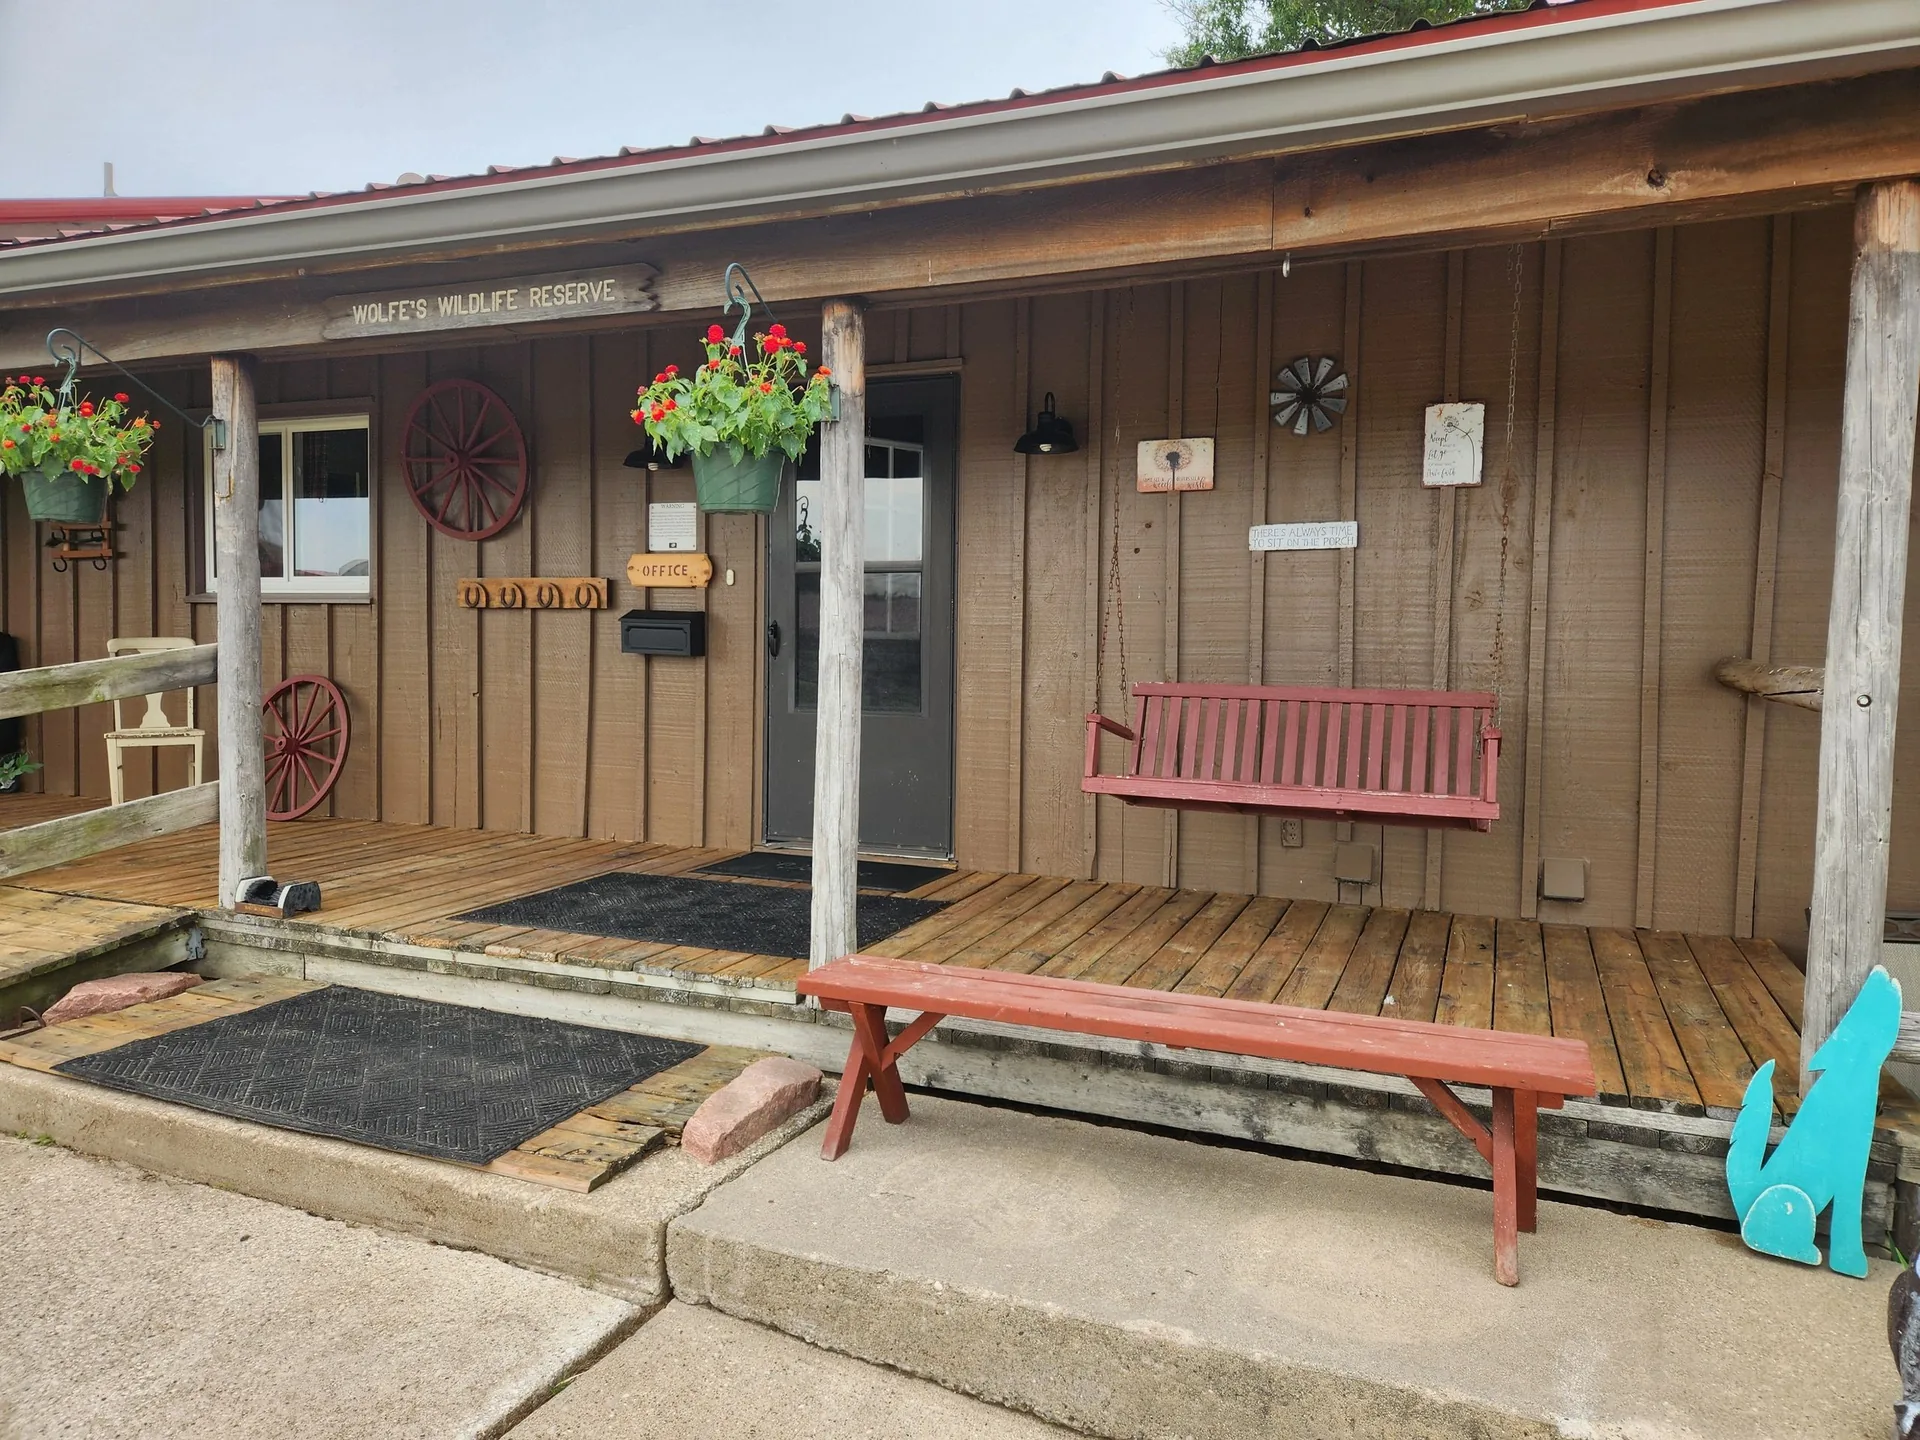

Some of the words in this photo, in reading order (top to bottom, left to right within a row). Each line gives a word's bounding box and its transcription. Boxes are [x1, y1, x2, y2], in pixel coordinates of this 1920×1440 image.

[352, 298, 427, 325] WOLFE'S
[438, 288, 518, 317] WILDLIFE
[529, 279, 615, 307] RESERVE
[1252, 528, 1286, 538] THERE'S
[1289, 527, 1327, 537] ALWAYS
[1329, 525, 1353, 536] TIME
[1252, 538, 1265, 548] TO
[1267, 538, 1282, 548] SIT
[1287, 538, 1299, 547] ON
[1302, 538, 1319, 547] THE
[1323, 537, 1354, 546] PORCH
[642, 564, 688, 577] OFFICE
